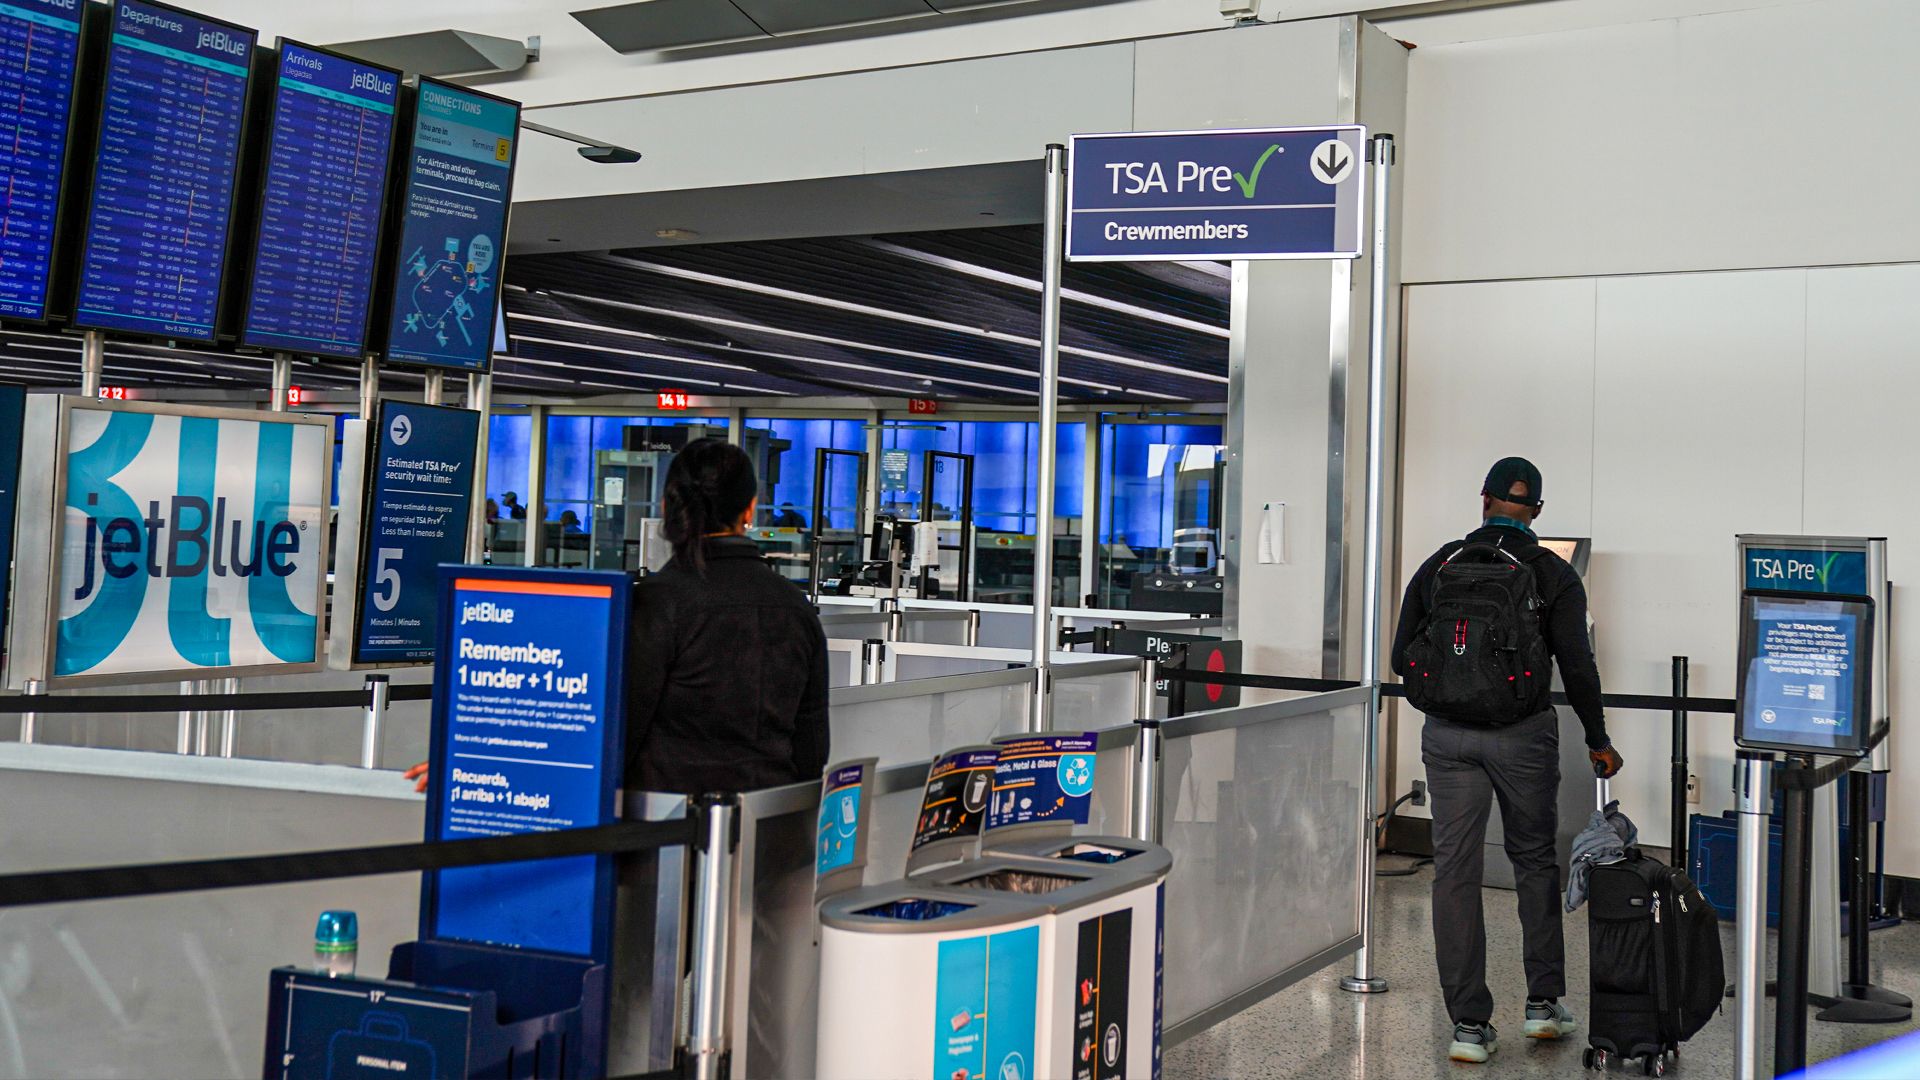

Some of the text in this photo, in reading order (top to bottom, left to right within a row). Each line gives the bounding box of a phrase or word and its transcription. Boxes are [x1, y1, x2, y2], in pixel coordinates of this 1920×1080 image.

[120, 4, 184, 33] Departures
[119, 20, 146, 36] Salidas
[195, 26, 246, 57] jetBlue
[285, 50, 324, 72] Arrivals
[284, 66, 313, 80] Llegadas
[349, 68, 394, 96] jetBlue
[423, 89, 482, 116] CONNECTIONS
[420, 121, 432, 132] You
[432, 125, 442, 135] are
[499, 144, 506, 158] 5
[417, 155, 428, 165] For
[450, 163, 461, 173] and
[462, 166, 477, 176] other
[416, 166, 445, 180] terminals,
[446, 172, 468, 185] proceed
[468, 176, 474, 185] to
[474, 178, 485, 190] bag
[1104, 160, 1233, 195] TSA Pre
[1104, 219, 1249, 242] Crewmembers
[660, 393, 674, 406] 14
[912, 399, 927, 411] 15
[386, 456, 424, 471] Estimated
[425, 460, 440, 472] TSA
[385, 470, 453, 485] security wait time:
[382, 500, 453, 514] Tiempo estimado de espera
[388, 516, 416, 525] seguridad
[416, 516, 427, 525] TSA
[382, 526, 445, 538] Less than menos de
[1752, 557, 1815, 581] TSA Pre
[373, 547, 404, 612] 5
[460, 600, 515, 626] jetBlue
[370, 617, 421, 627] Minutes Minutos
[1776, 622, 1792, 630] Your
[1792, 622, 1806, 630] TSA
[1768, 630, 1798, 638] privileges
[1799, 630, 1814, 639] may
[1824, 632, 1847, 640] denied
[1774, 636, 1784, 644] be
[1784, 638, 1807, 646] subject
[1814, 640, 1847, 648] additional
[459, 637, 564, 670] Remember,
[1764, 644, 1789, 652] security
[1789, 645, 1820, 653] measures
[1826, 648, 1840, 656] you
[1840, 648, 1850, 656] do
[1780, 652, 1804, 660] present
[1809, 652, 1826, 661] REAL
[1768, 664, 1800, 676] beginning
[1800, 667, 1816, 676] May
[458, 664, 468, 686] 1
[470, 667, 526, 690] under
[542, 670, 553, 692] 1
[556, 672, 589, 700] up!
[484, 705, 494, 714] the
[1012, 760, 1030, 771] Metal
[1030, 760, 1036, 770] &
[1037, 759, 1057, 769] Glass
[452, 767, 510, 790] Recuerda,
[462, 787, 496, 804] arriba
[506, 790, 513, 805] 1
[512, 791, 550, 812] abajo!
[356, 1054, 408, 1072] PERSONAL ITEM
